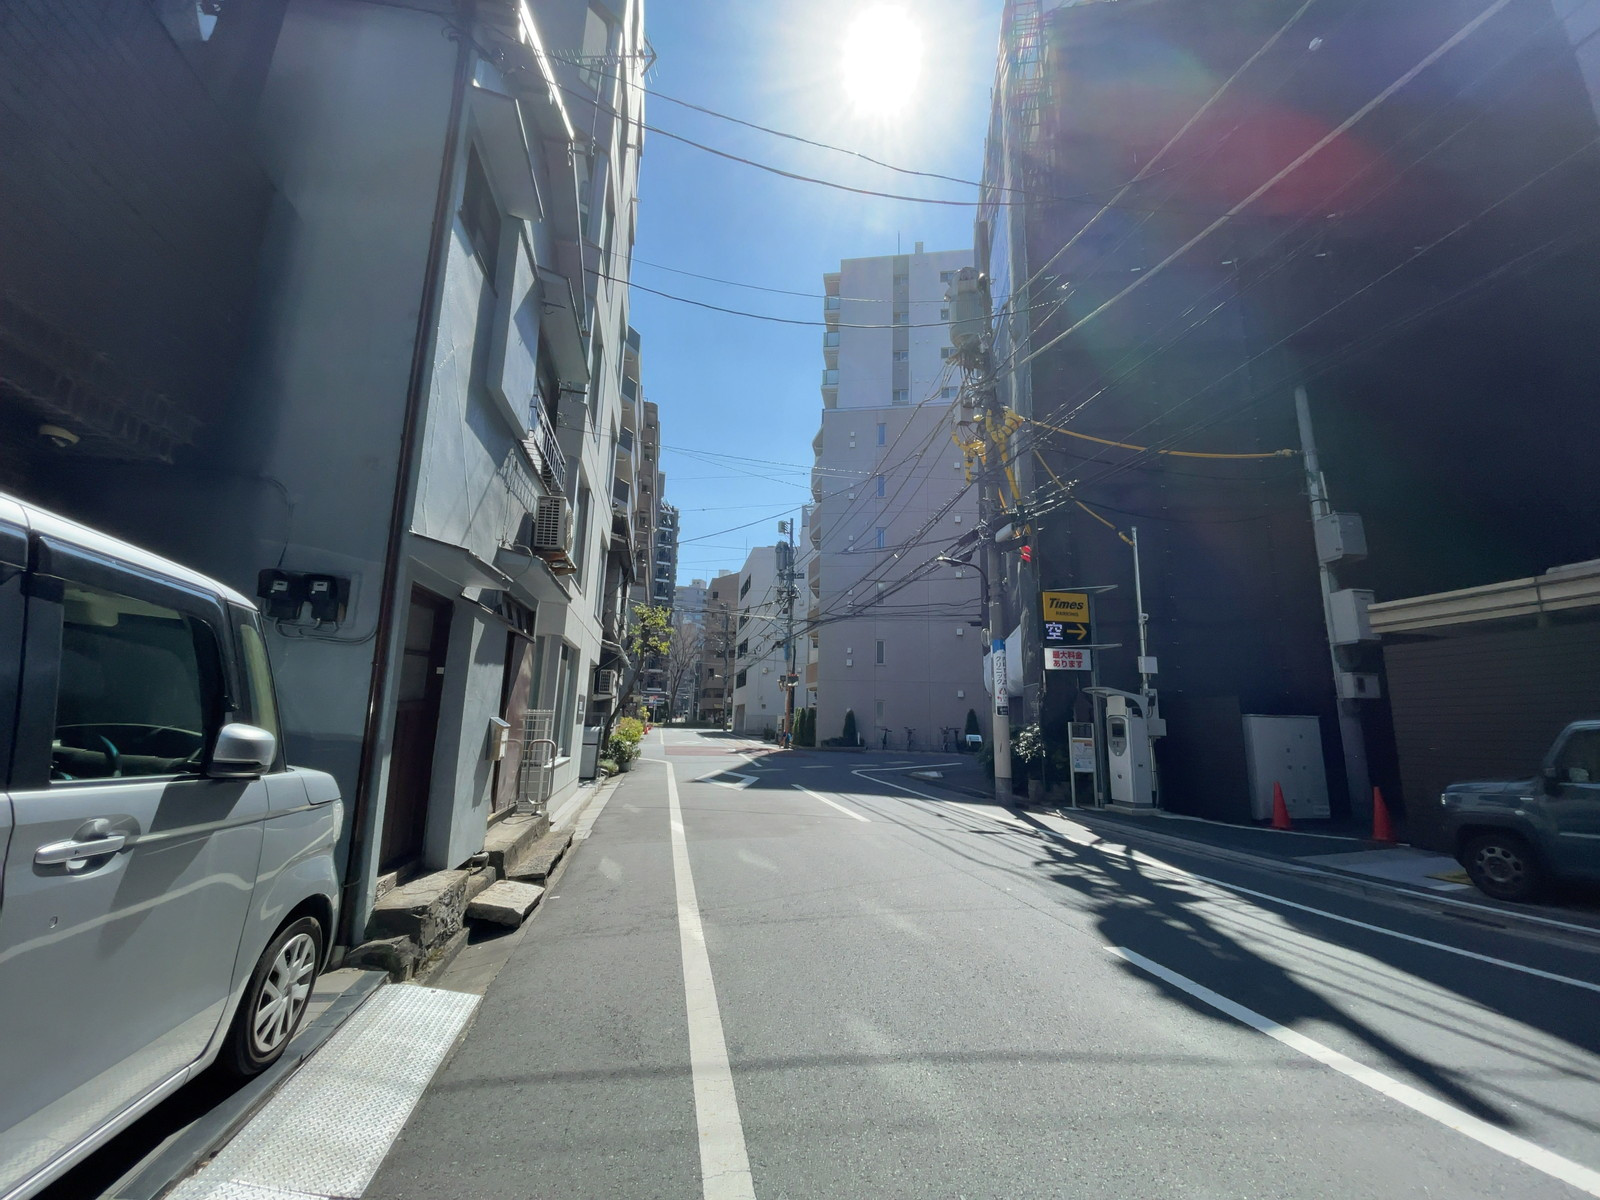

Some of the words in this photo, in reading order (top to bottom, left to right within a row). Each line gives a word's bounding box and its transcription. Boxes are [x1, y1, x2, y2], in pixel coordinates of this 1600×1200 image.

[1049, 598, 1084, 610] Times
[1045, 622, 1063, 640] 空
[1052, 651, 1082, 659] 最大料金
[1053, 660, 1083, 668] あります
